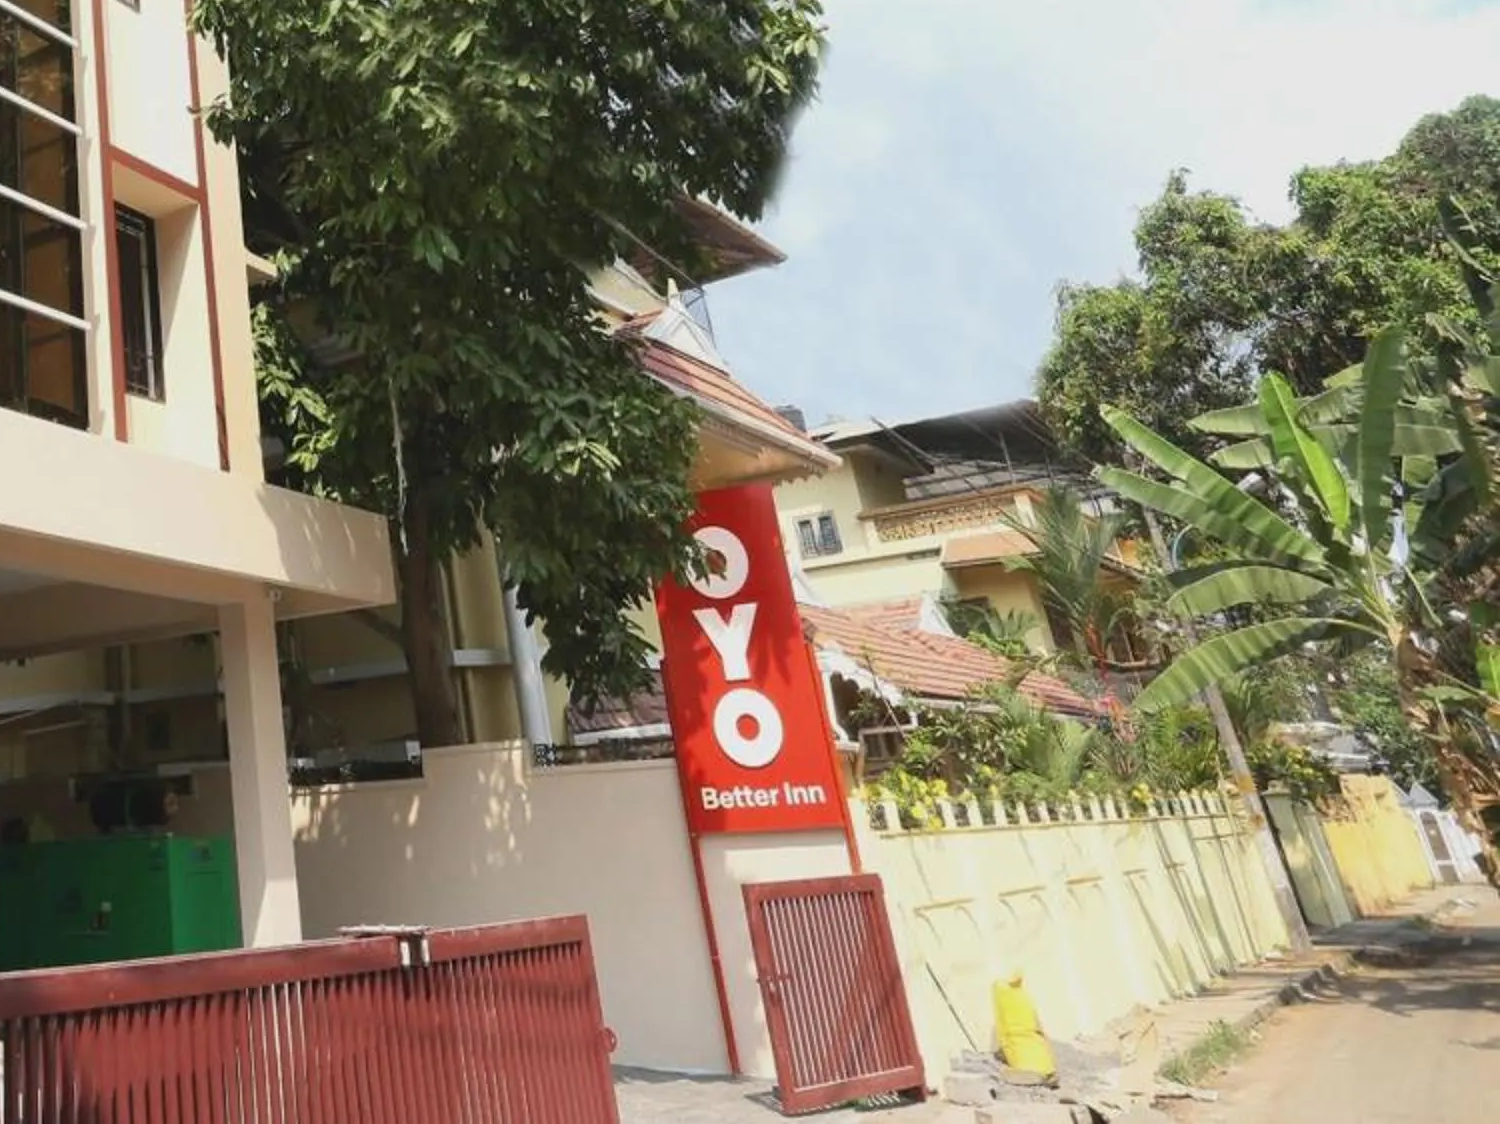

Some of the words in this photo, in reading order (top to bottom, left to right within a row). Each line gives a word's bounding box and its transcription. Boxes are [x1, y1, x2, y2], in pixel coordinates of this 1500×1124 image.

[686, 525, 784, 768] OYO
[701, 785, 779, 810] Better
[783, 781, 827, 805] Inn
